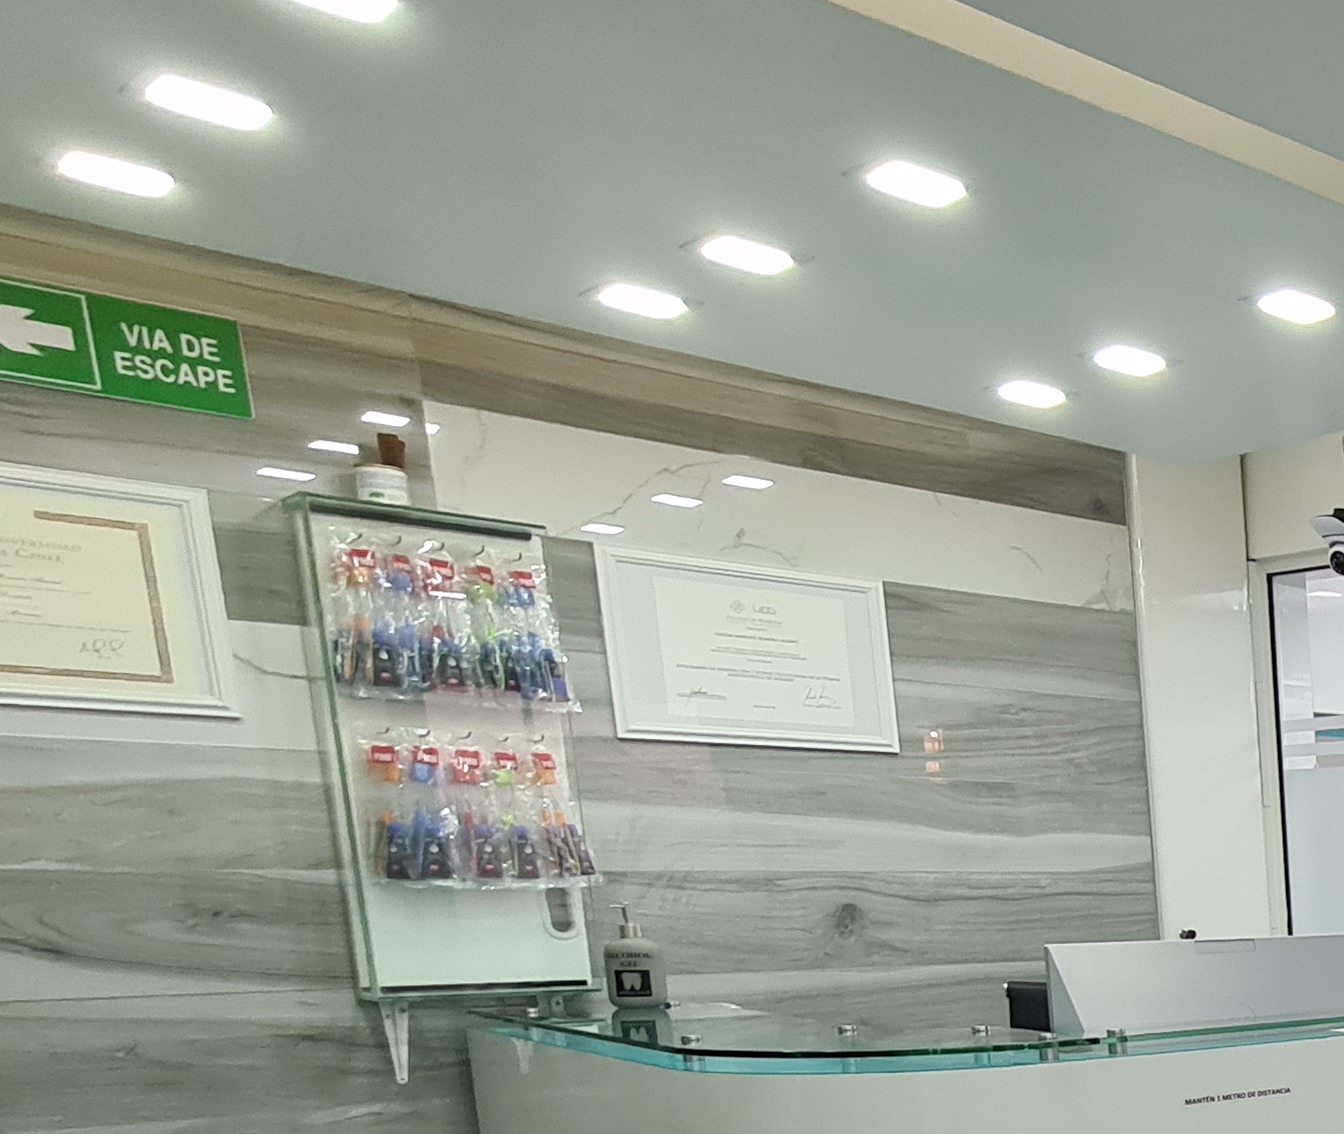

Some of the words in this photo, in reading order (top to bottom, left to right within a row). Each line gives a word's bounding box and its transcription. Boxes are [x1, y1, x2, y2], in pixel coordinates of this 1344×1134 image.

[120, 321, 174, 354] VIA
[179, 333, 221, 362] DE
[113, 351, 236, 394] ESCAPE
[1222, 1092, 1246, 1101] METRO
[1258, 1087, 1291, 1097] DISTANCIA
